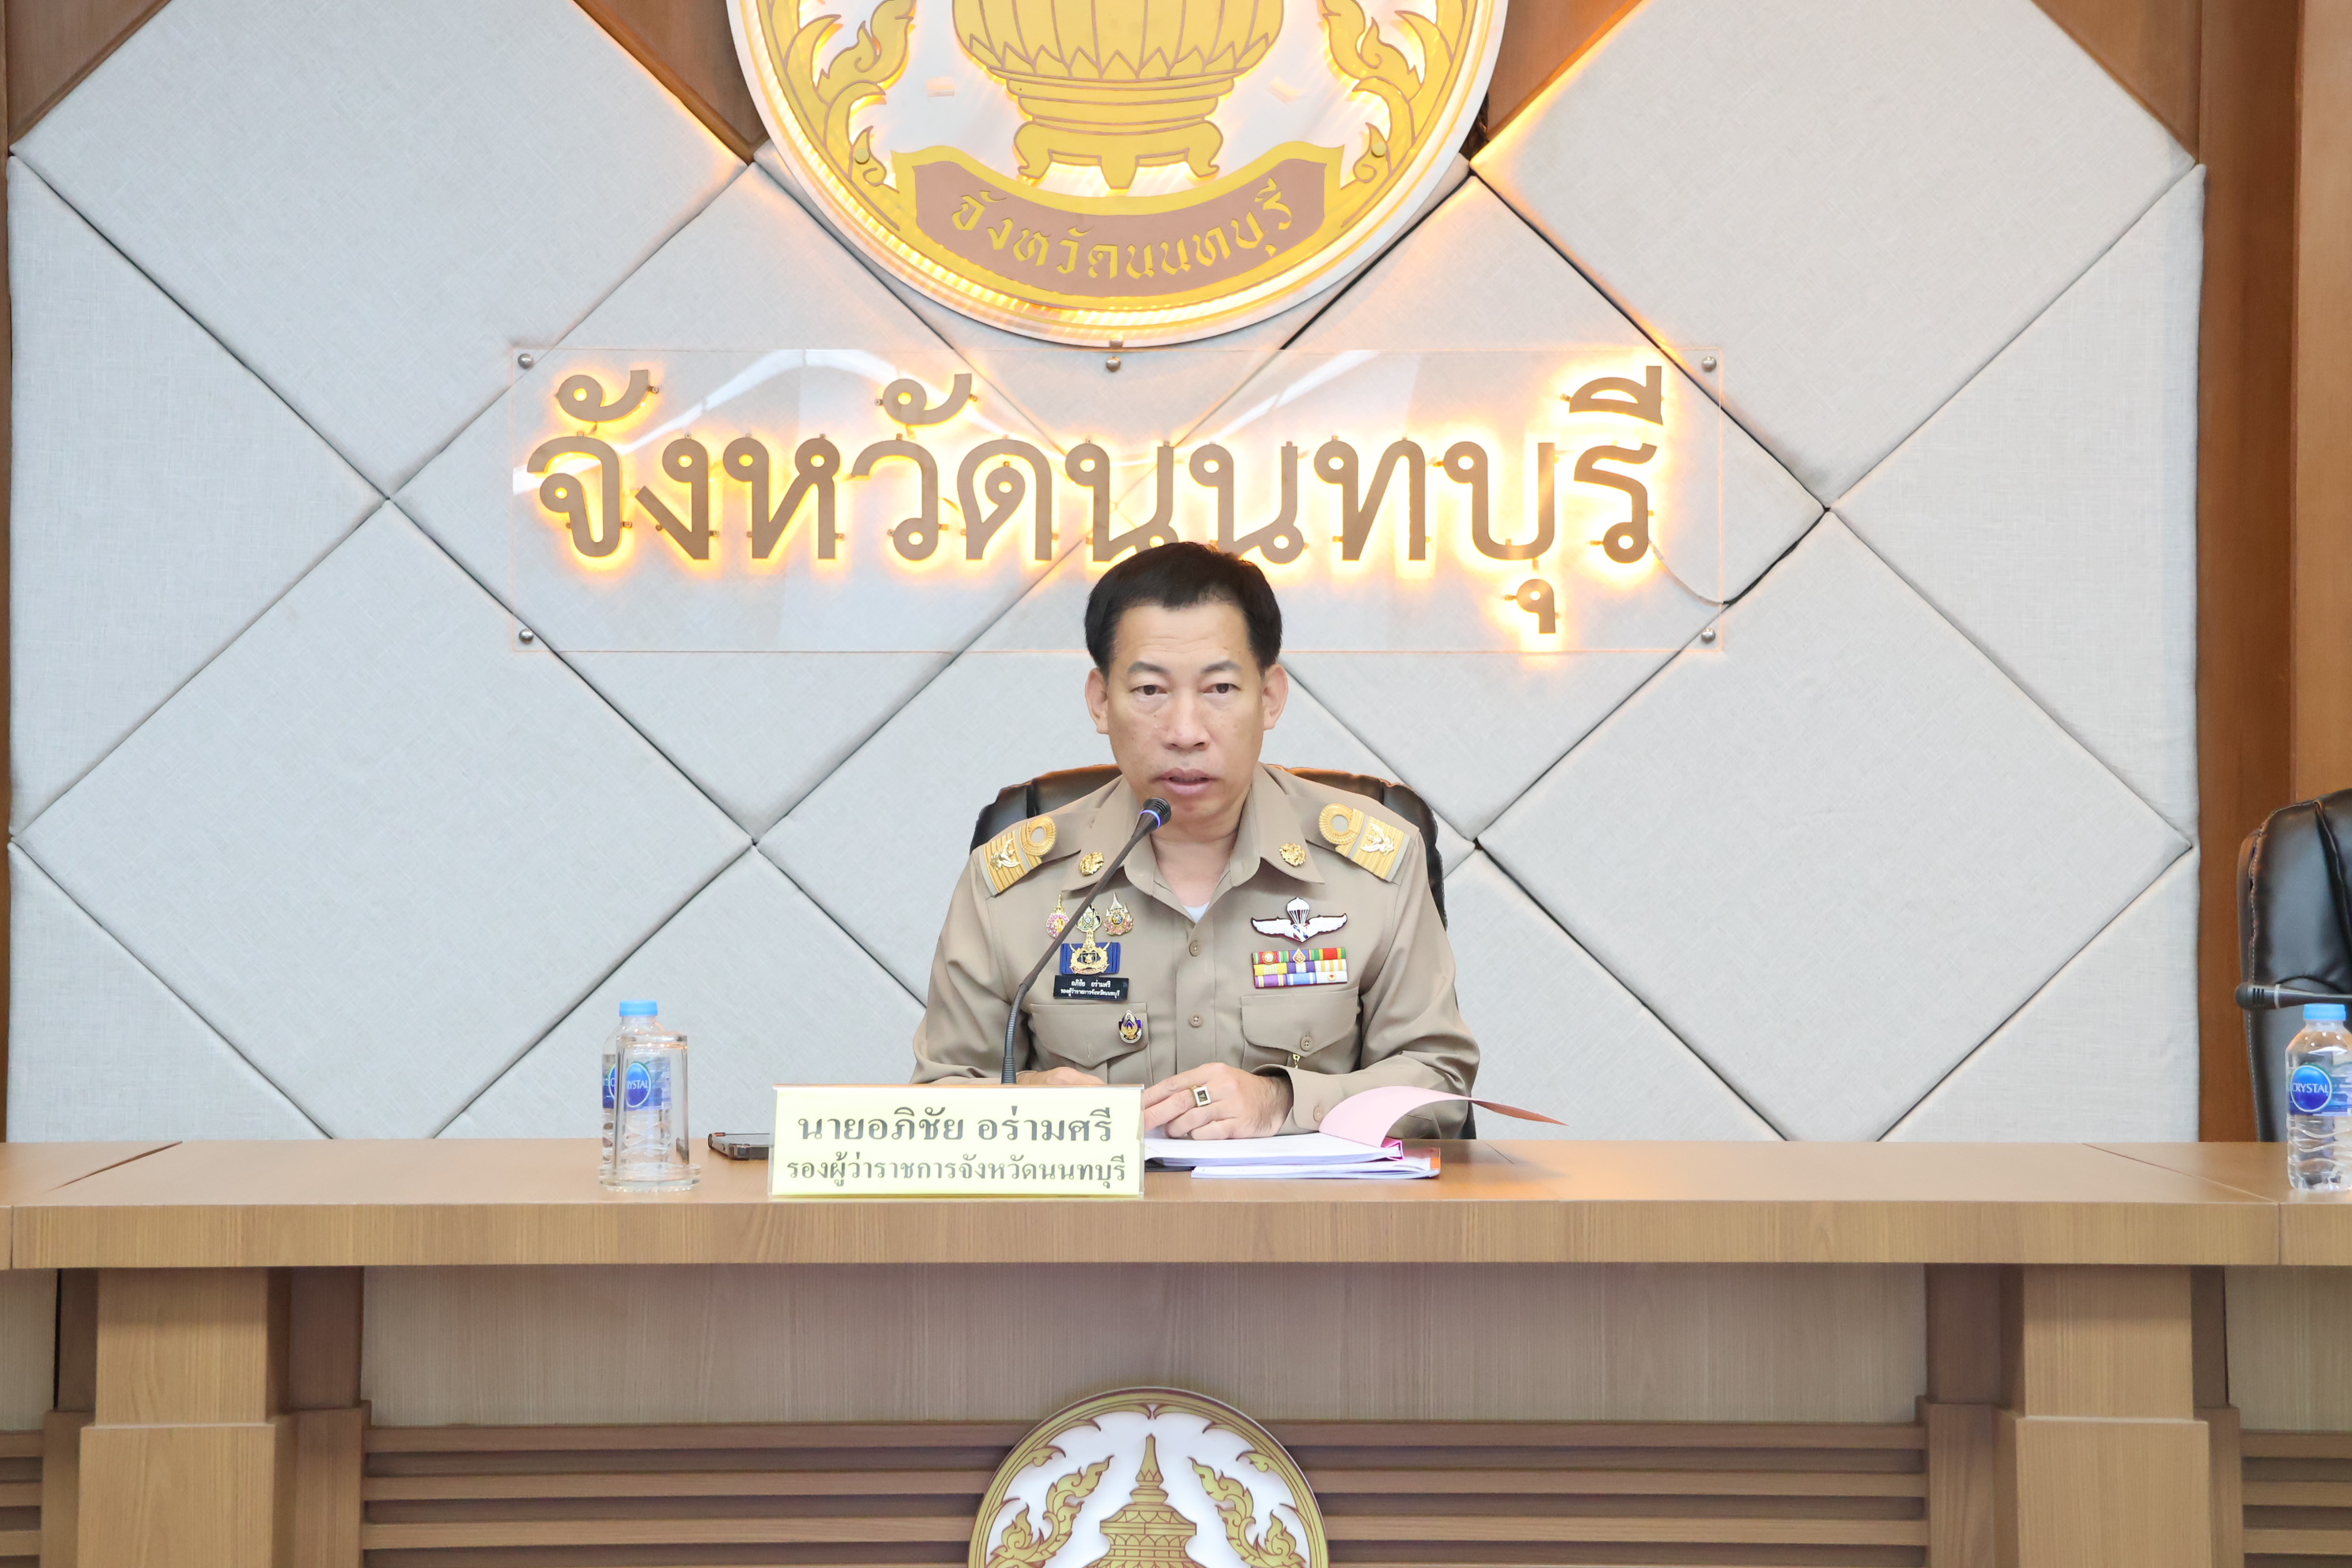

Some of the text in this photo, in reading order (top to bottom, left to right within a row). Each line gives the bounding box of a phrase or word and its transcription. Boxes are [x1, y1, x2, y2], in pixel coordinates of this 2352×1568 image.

[952, 179, 1292, 279] จังหวัดนนทบุรี
[527, 365, 1664, 633] จังหวัดนนทบุรี
[797, 1106, 1112, 1142] นายอภิชัย อร่ามศรี
[786, 1152, 1125, 1188] รองผู้ว่าราชการจังหวัดนนทบุรี
